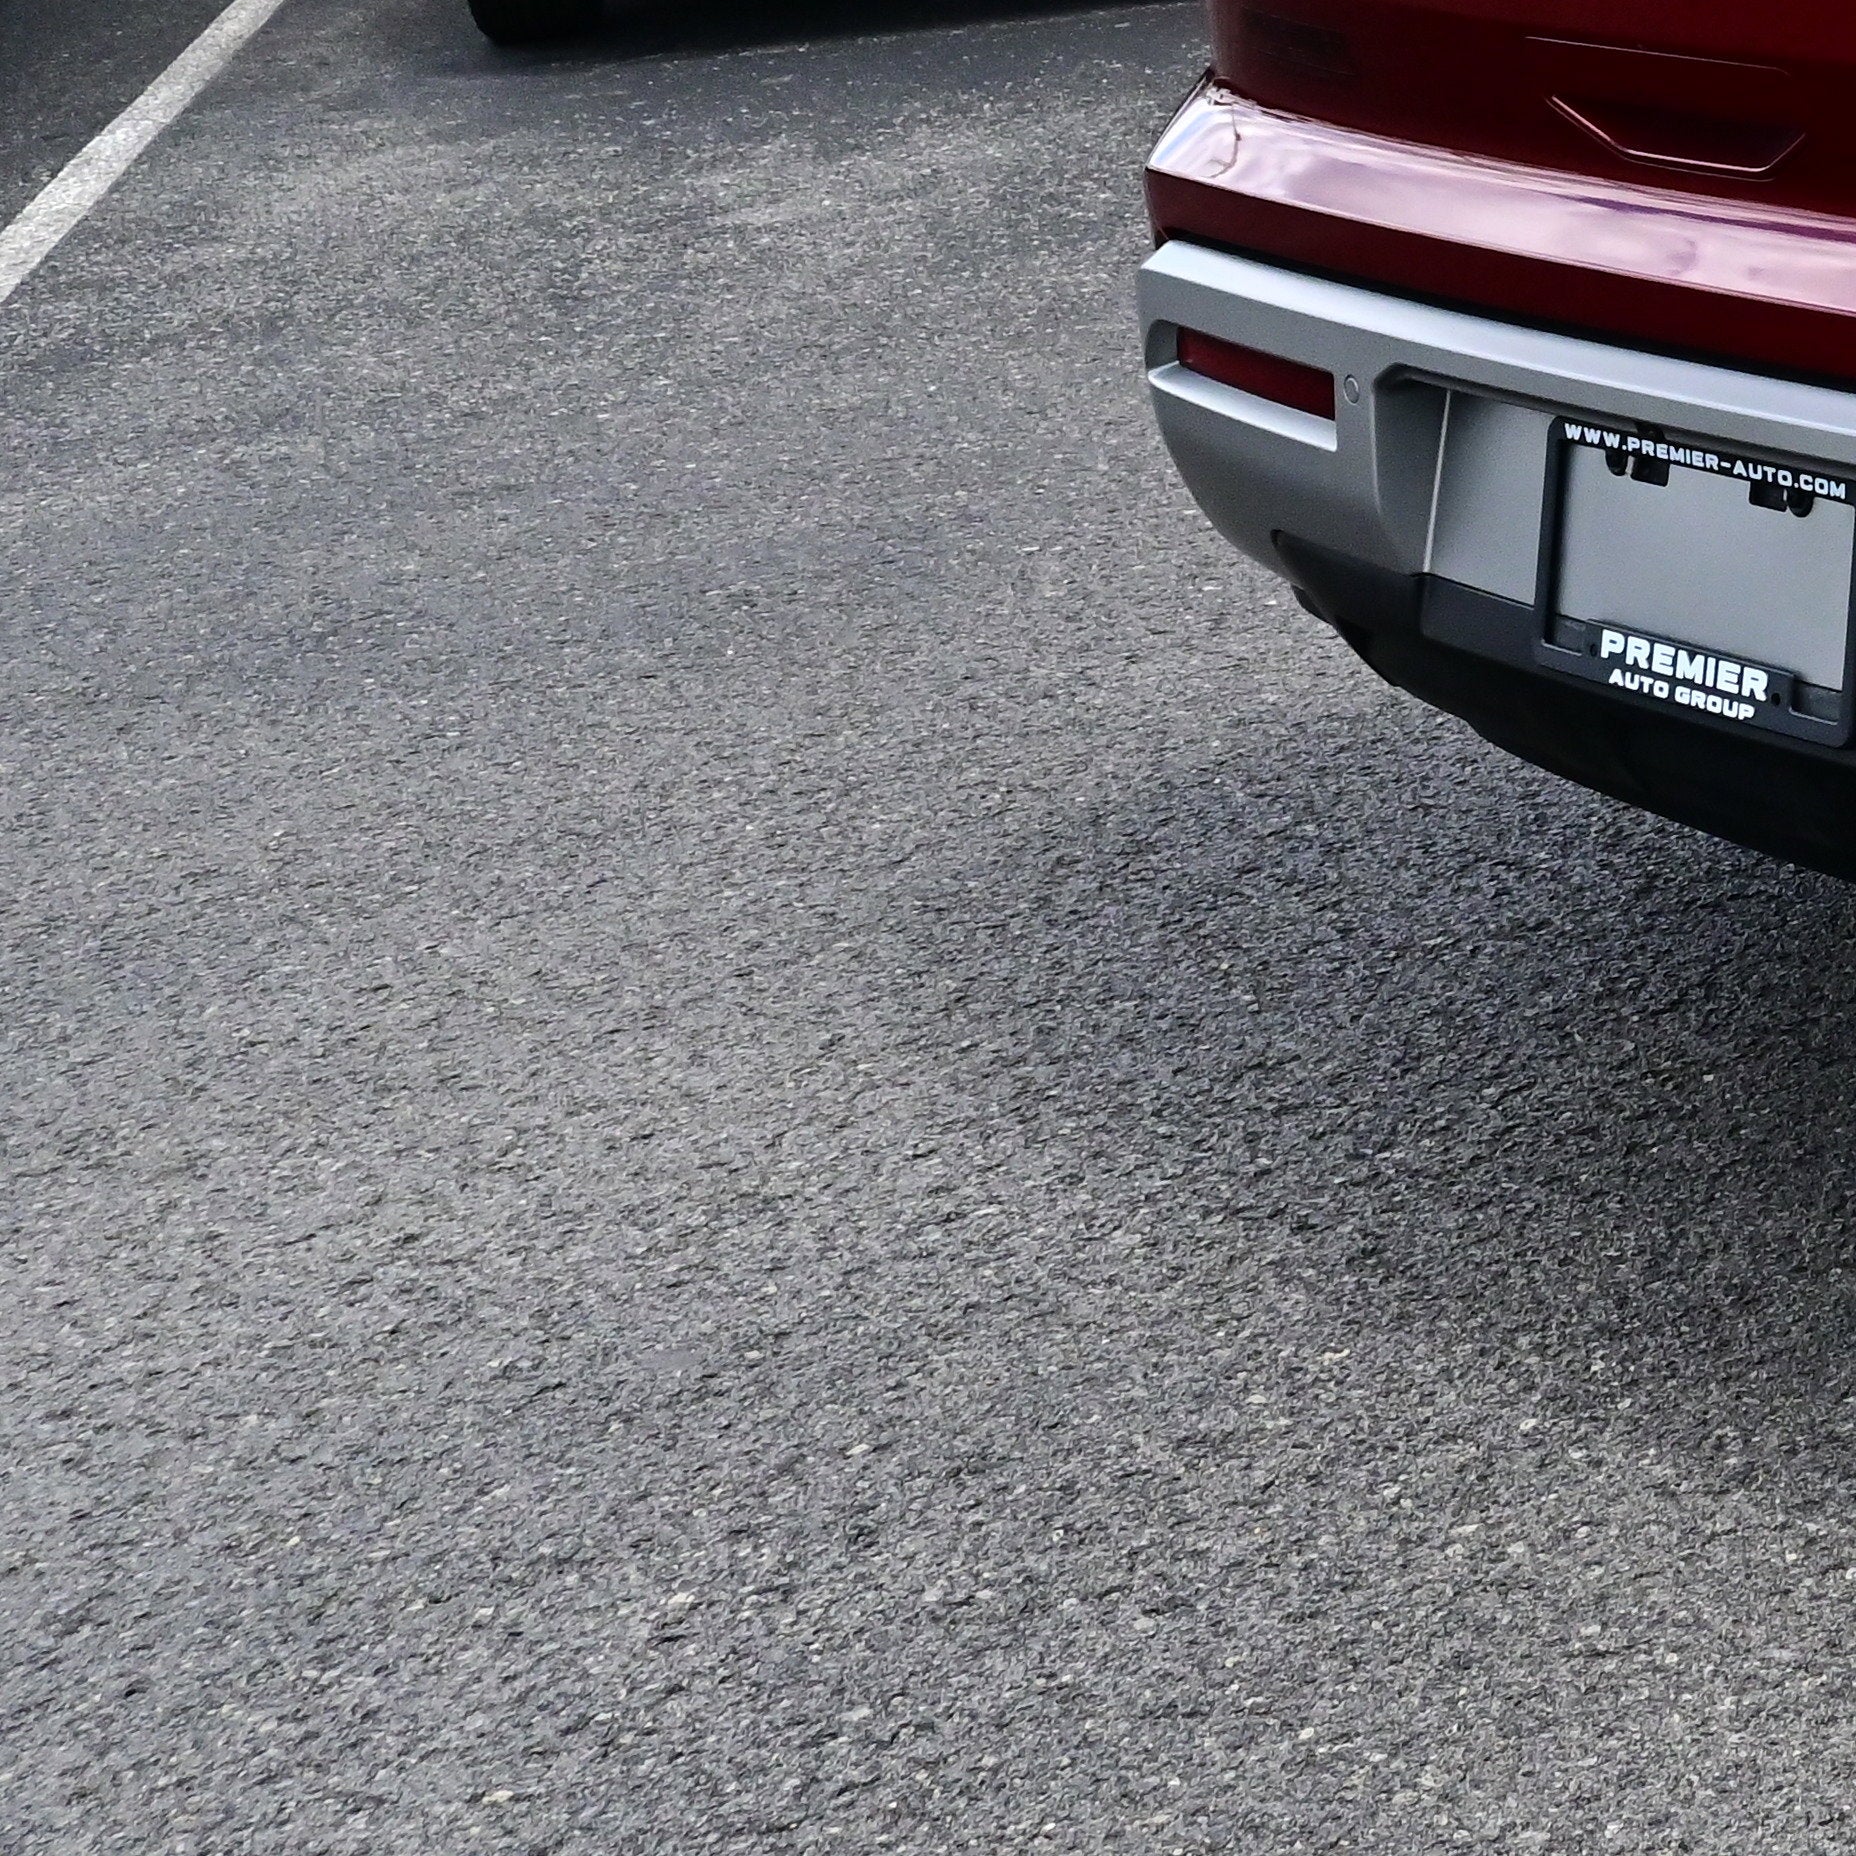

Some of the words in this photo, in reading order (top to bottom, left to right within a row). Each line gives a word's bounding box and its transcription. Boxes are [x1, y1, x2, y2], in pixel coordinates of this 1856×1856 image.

[1564, 422, 1847, 500] WWW.PREMIER-AUTO.COM
[1600, 628, 1769, 702] PREMIER
[1608, 668, 1670, 700] AUTO
[1674, 686, 1755, 721] GROUP
